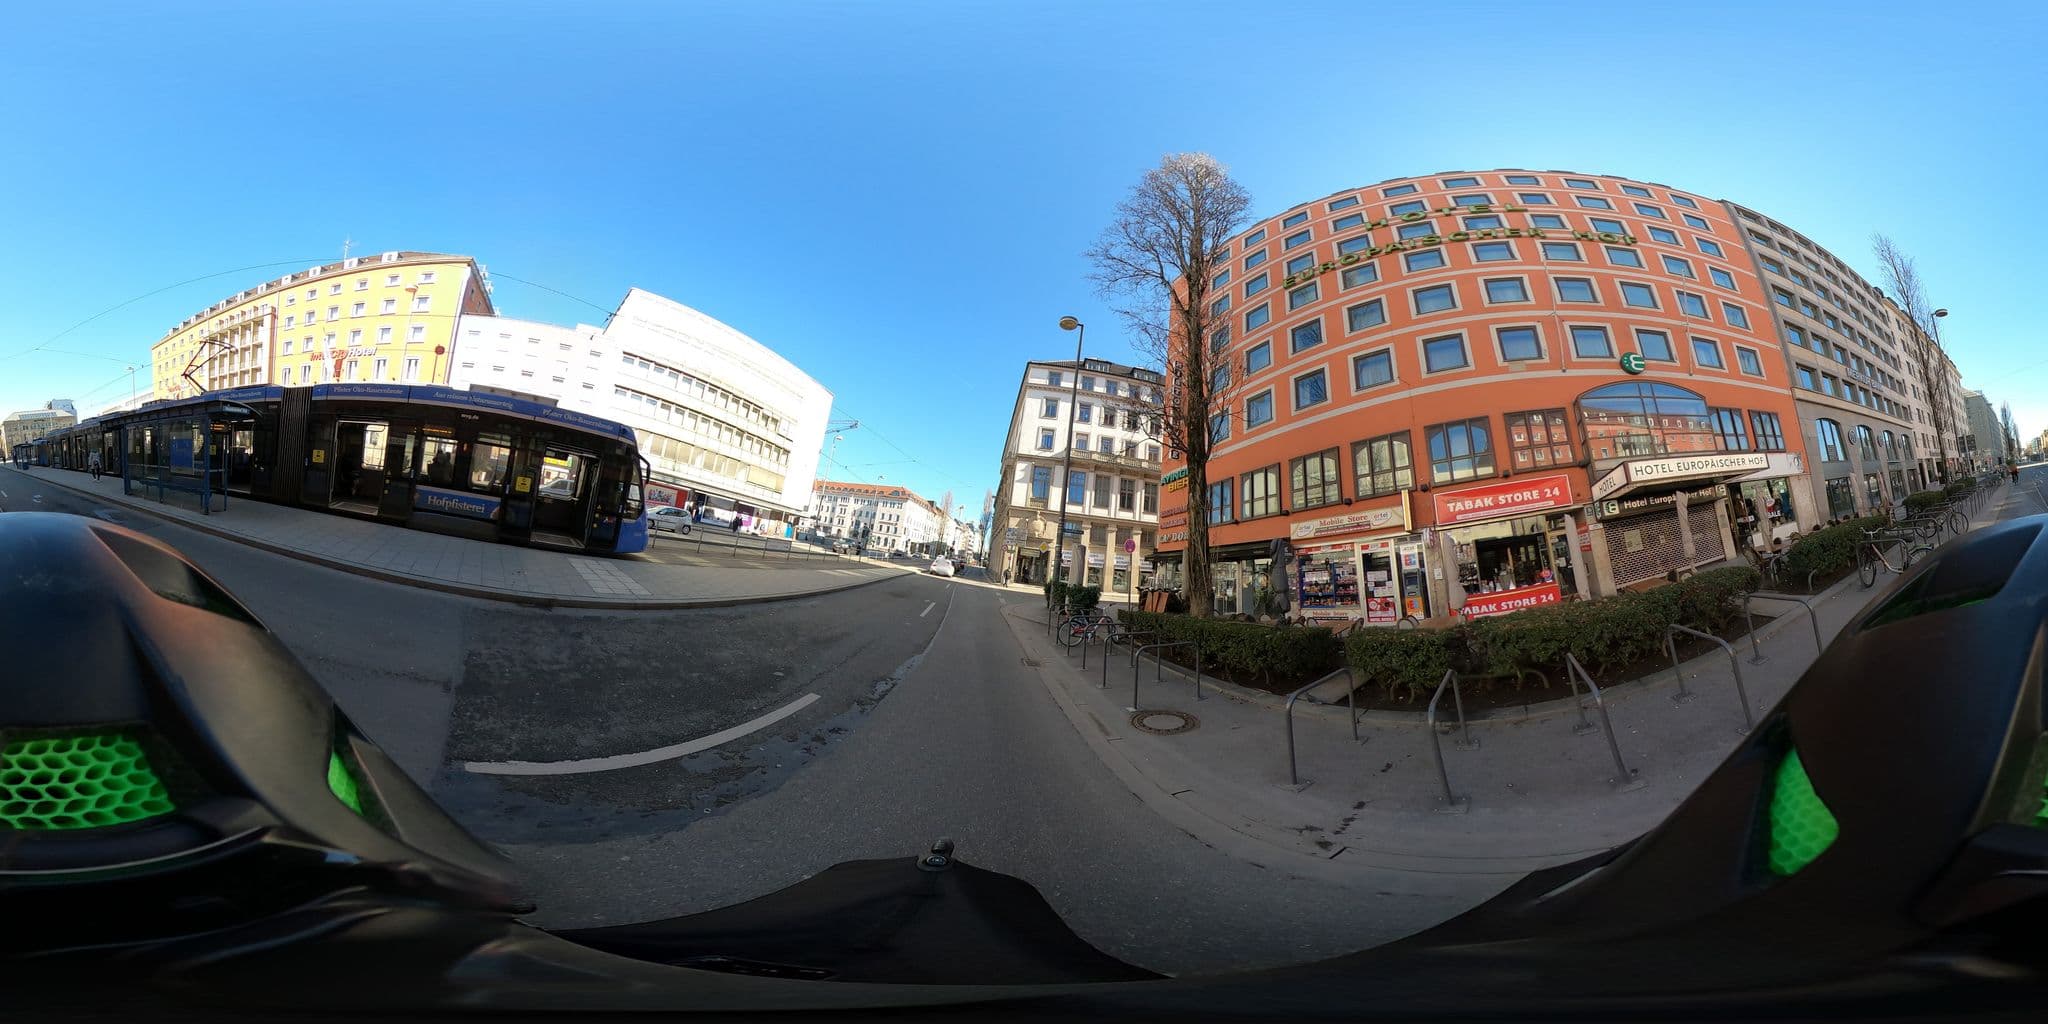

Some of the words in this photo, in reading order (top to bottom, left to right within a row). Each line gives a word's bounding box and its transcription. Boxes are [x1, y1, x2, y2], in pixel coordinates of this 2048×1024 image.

[1365, 203, 1528, 231] HOTEL
[1572, 230, 1638, 246] HOF
[1634, 464, 1674, 477] HOTEL
[1167, 476, 1188, 492] BIER
[1599, 477, 1617, 495] HOTEL
[427, 495, 486, 513] Hofpfisterei
[1447, 497, 1495, 512] TABAK
[1498, 489, 1541, 505] STORE
[1543, 486, 1561, 498] 24
[1624, 498, 1648, 509] Hotel
[1319, 518, 1343, 527] Mobile
[1347, 514, 1369, 523] Store
[1500, 596, 1538, 610] STORE
[1540, 593, 1555, 603] 24
